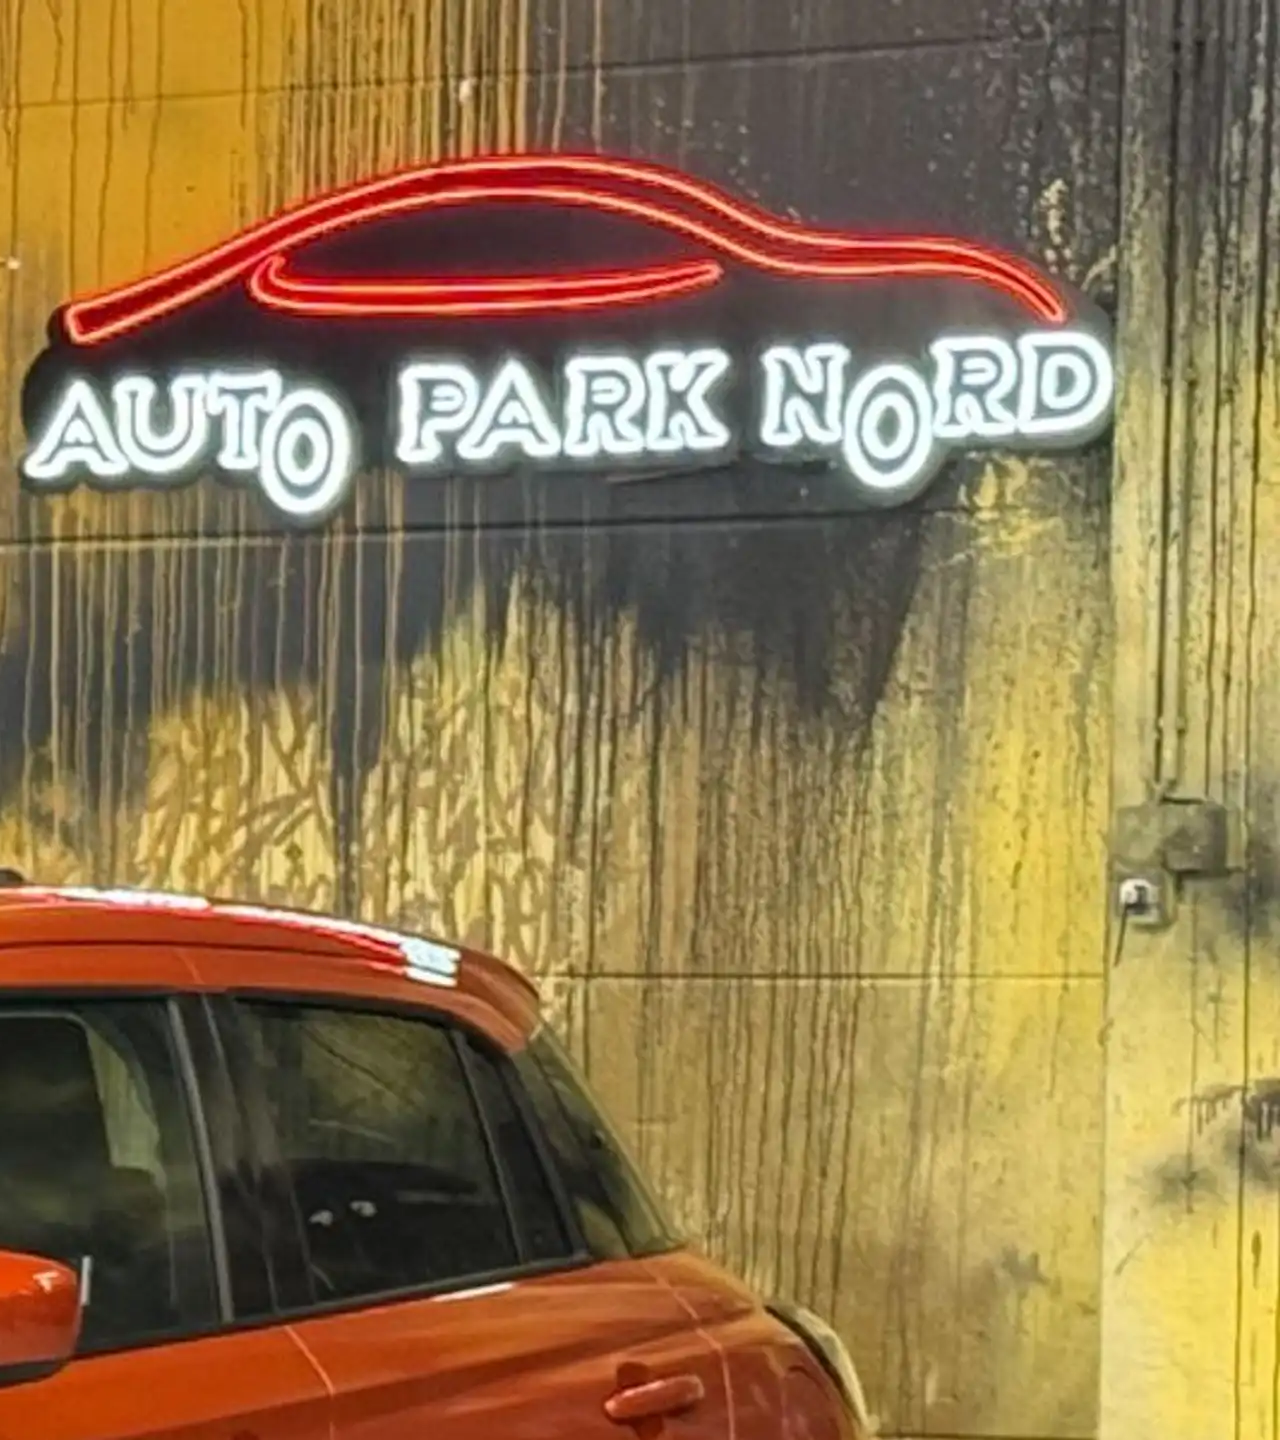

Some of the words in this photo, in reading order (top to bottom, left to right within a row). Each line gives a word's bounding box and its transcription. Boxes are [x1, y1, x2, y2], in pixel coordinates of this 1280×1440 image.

[26, 370, 352, 514] AUTO
[396, 349, 730, 462] PARK
[762, 330, 1115, 490] NORD
